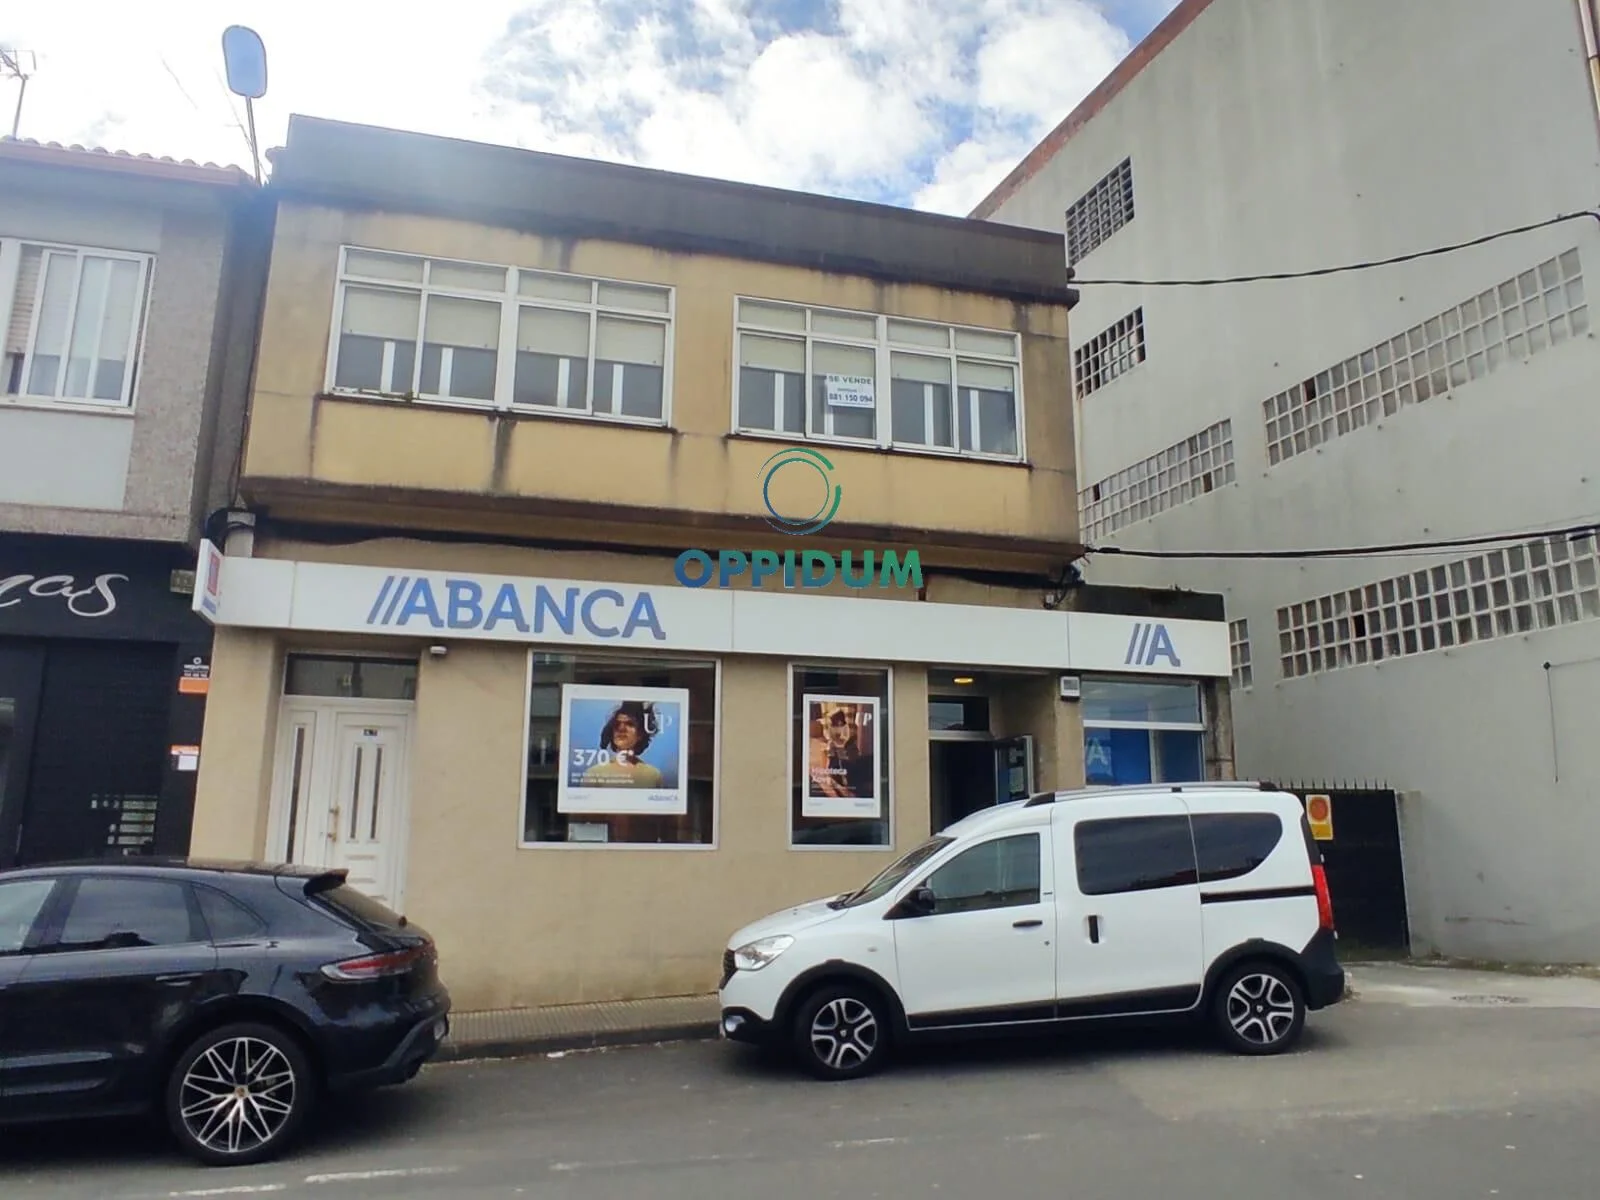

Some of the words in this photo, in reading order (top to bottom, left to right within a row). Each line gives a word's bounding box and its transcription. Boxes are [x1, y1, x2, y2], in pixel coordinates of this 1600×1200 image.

[843, 376, 872, 384] VENDE
[399, 577, 666, 641] ABANCA
[573, 749, 610, 766] 370
